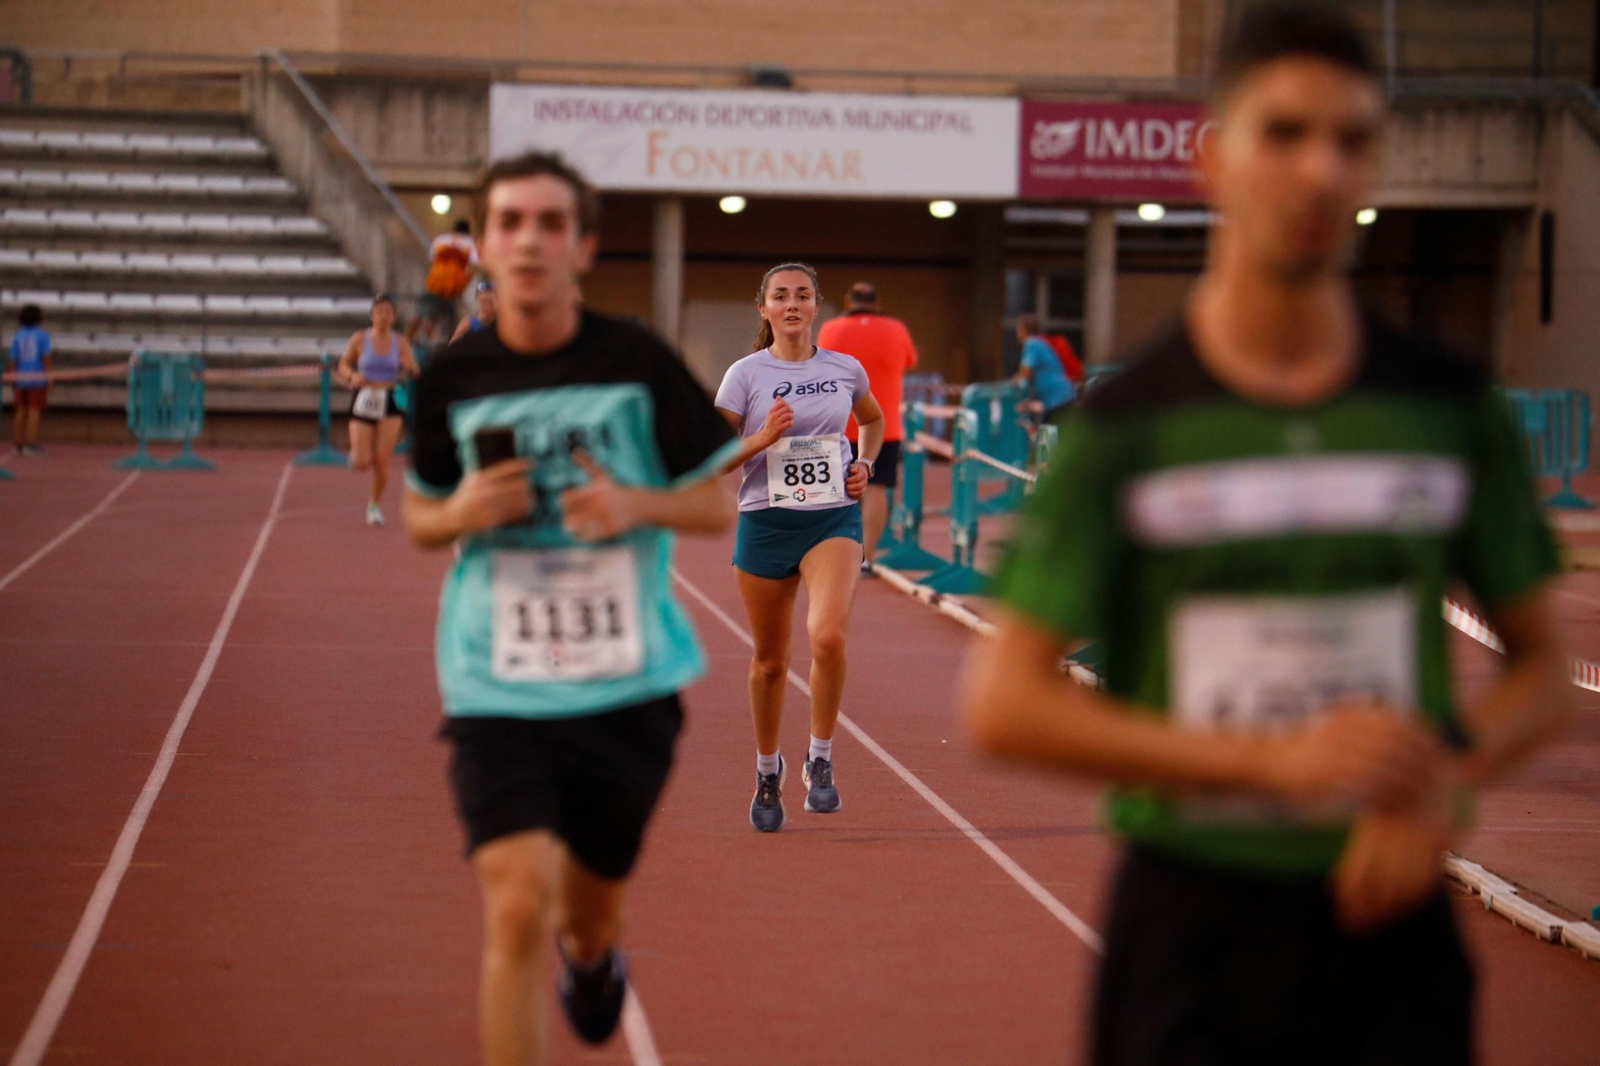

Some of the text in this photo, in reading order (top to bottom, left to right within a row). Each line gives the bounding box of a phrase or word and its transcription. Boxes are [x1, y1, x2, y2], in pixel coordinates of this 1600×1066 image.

[533, 98, 974, 133] INSTALACIÓN DEPORTIVA MUNICIPAL
[795, 380, 838, 395] asics
[784, 461, 830, 486] 883
[511, 597, 624, 641] 1131
